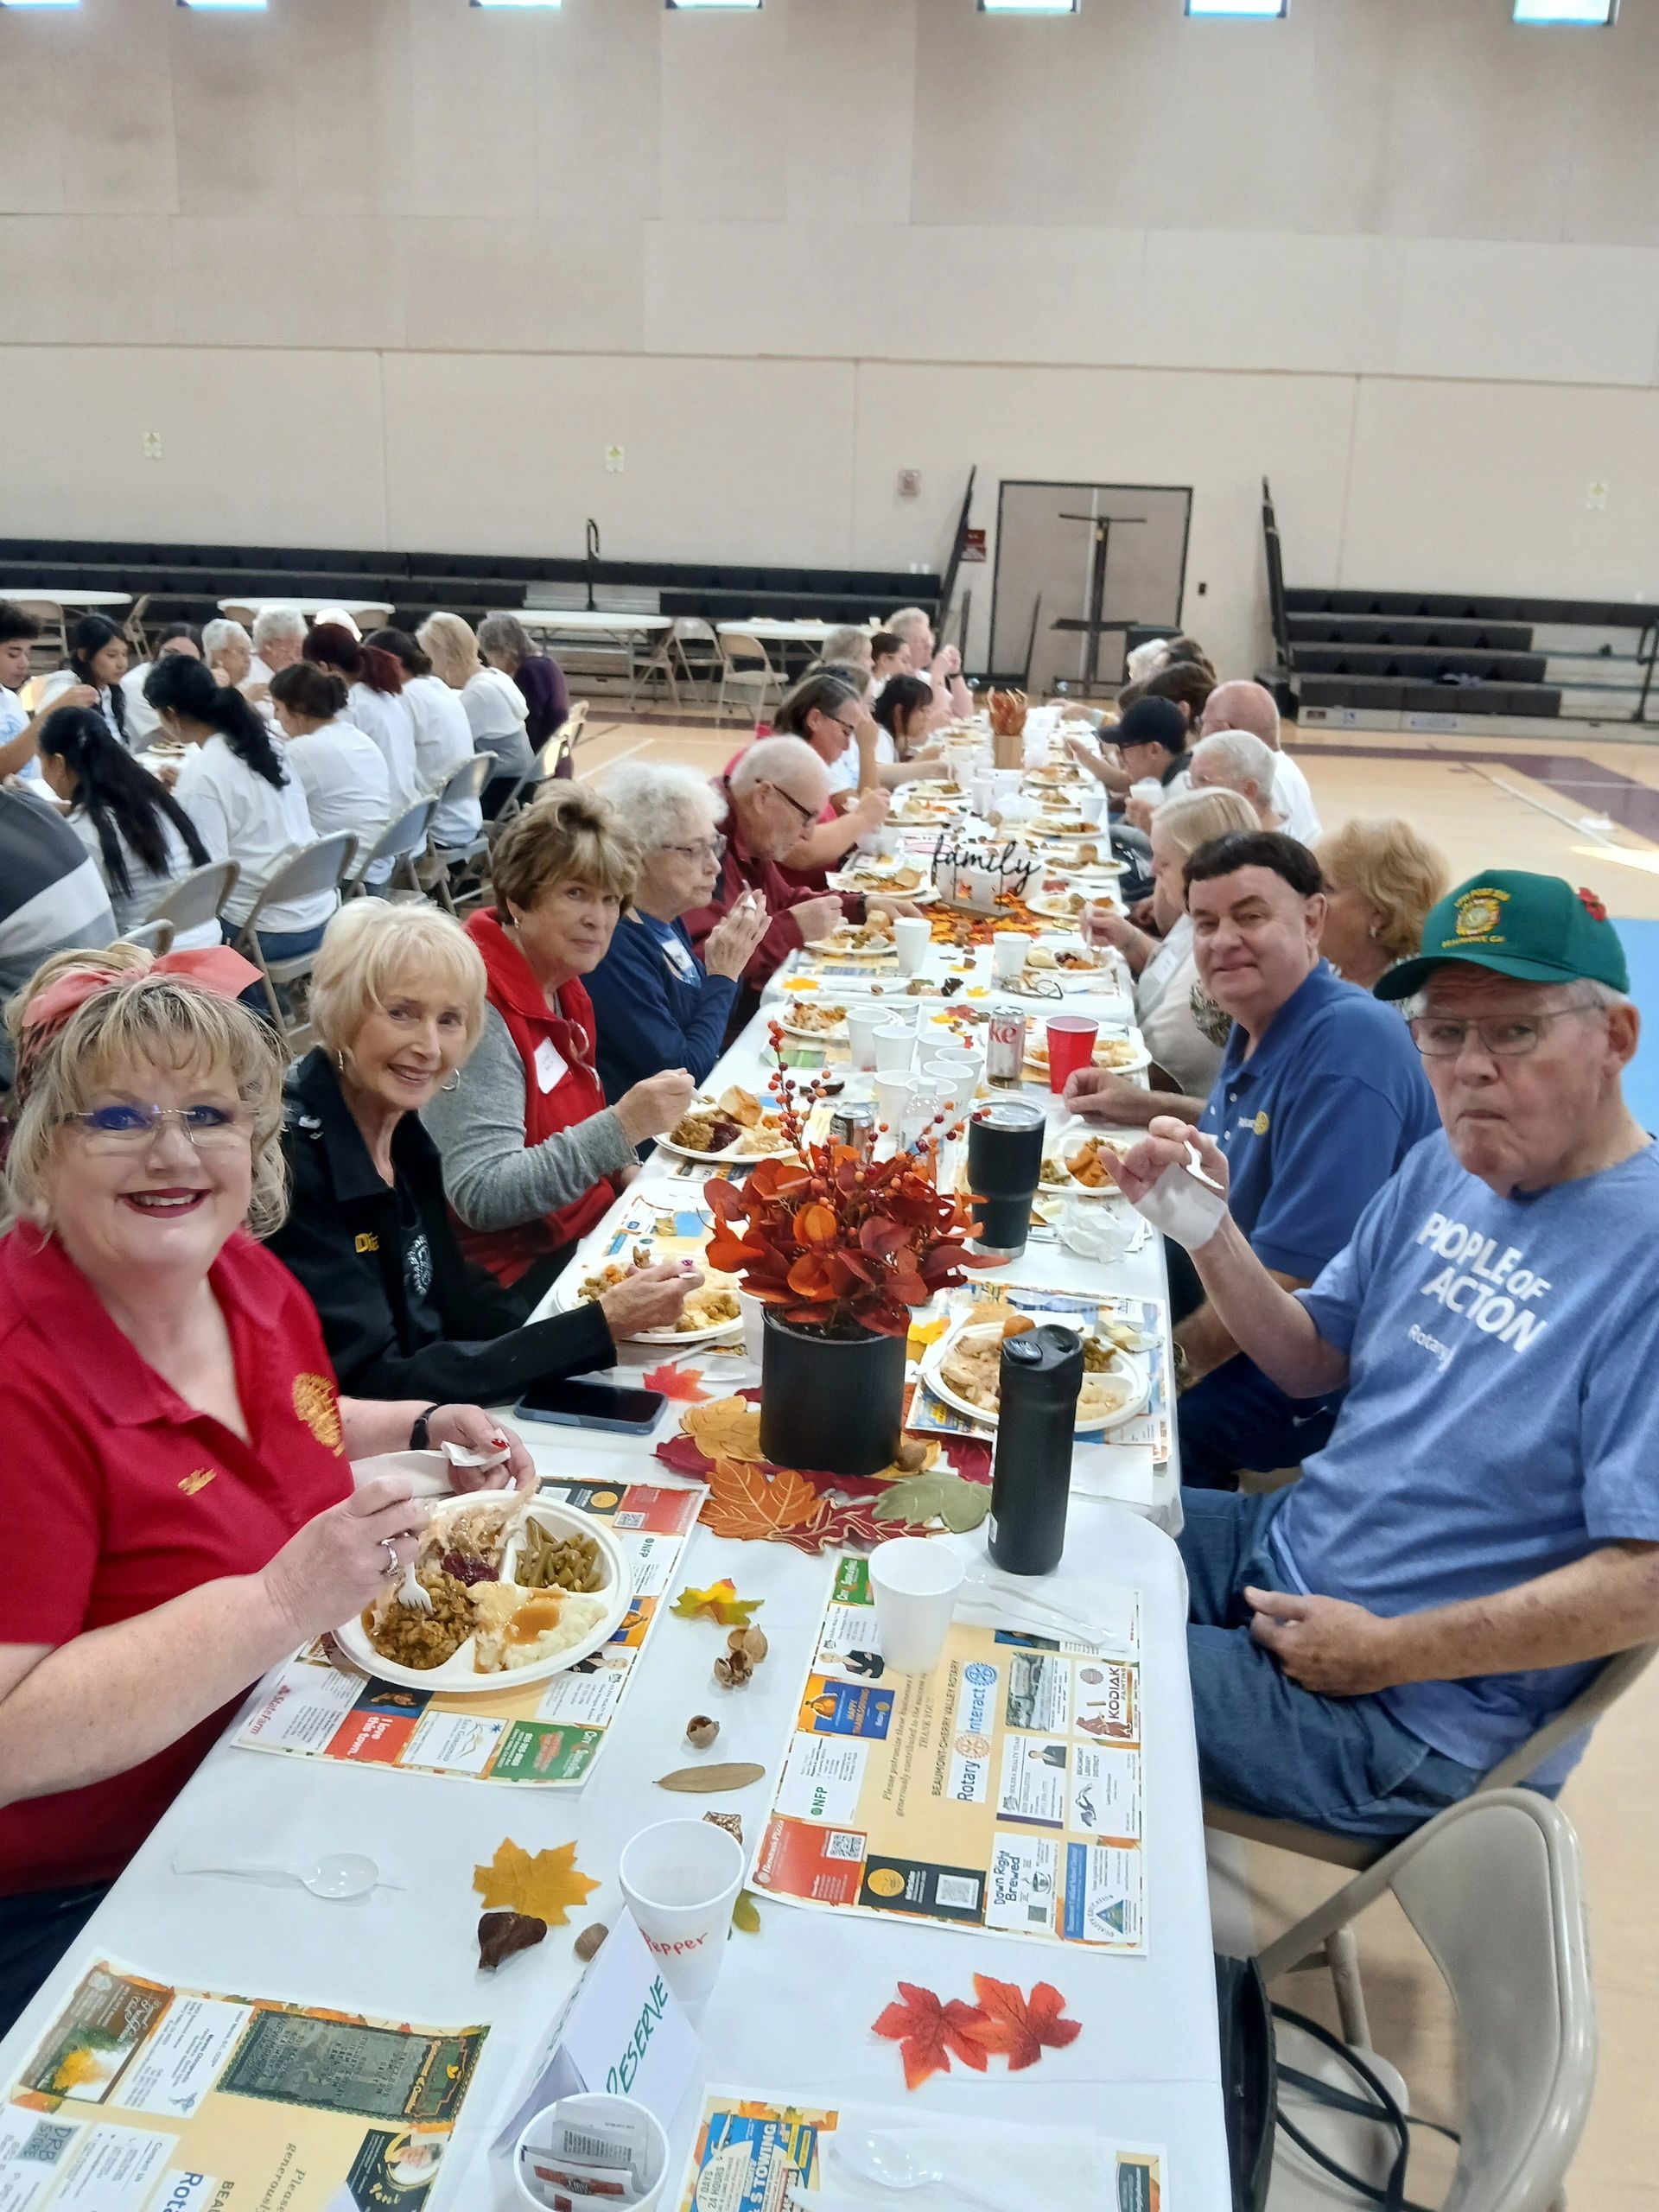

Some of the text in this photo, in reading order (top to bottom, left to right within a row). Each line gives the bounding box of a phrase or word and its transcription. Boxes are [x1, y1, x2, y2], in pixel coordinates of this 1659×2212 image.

[931, 835, 1041, 895] family
[1506, 1269, 1553, 1301] OF
[1408, 1323, 1455, 1372] Rotary
[639, 1542, 653, 1558] NFP
[916, 1680, 925, 1706] success
[1108, 1667, 1122, 1719] KODIAK
[345, 1716, 381, 1757] this town.
[369, 1722, 391, 1740] love
[883, 1679, 912, 1801] Please patronize these businesses
[911, 1719, 918, 1727] to
[920, 1719, 931, 1749] THANK
[931, 1660, 960, 1797] BEAUMONT-CHERRY VALLEY ROTARY
[903, 1729, 917, 1772] contributed
[957, 1688, 988, 1802] Rotary Interact
[1076, 1747, 1085, 1776] BEAUMONT
[1092, 1754, 1101, 1777] DISTRICT
[811, 1786, 828, 1807] NFP
[897, 1775, 911, 1816] generously
[993, 1849, 1011, 1905] Down Right
[1005, 1856, 1020, 1902] Brewed
[639, 1927, 709, 1956] Pepper
[35, 2122, 72, 2164] DRB
[133, 2141, 162, 2183] Contact Us
[753, 2122, 777, 2189] TOWING
[700, 2170, 714, 2193] DAYS
[707, 2164, 724, 2209] 24 HOURS
[749, 2191, 763, 2203] S
